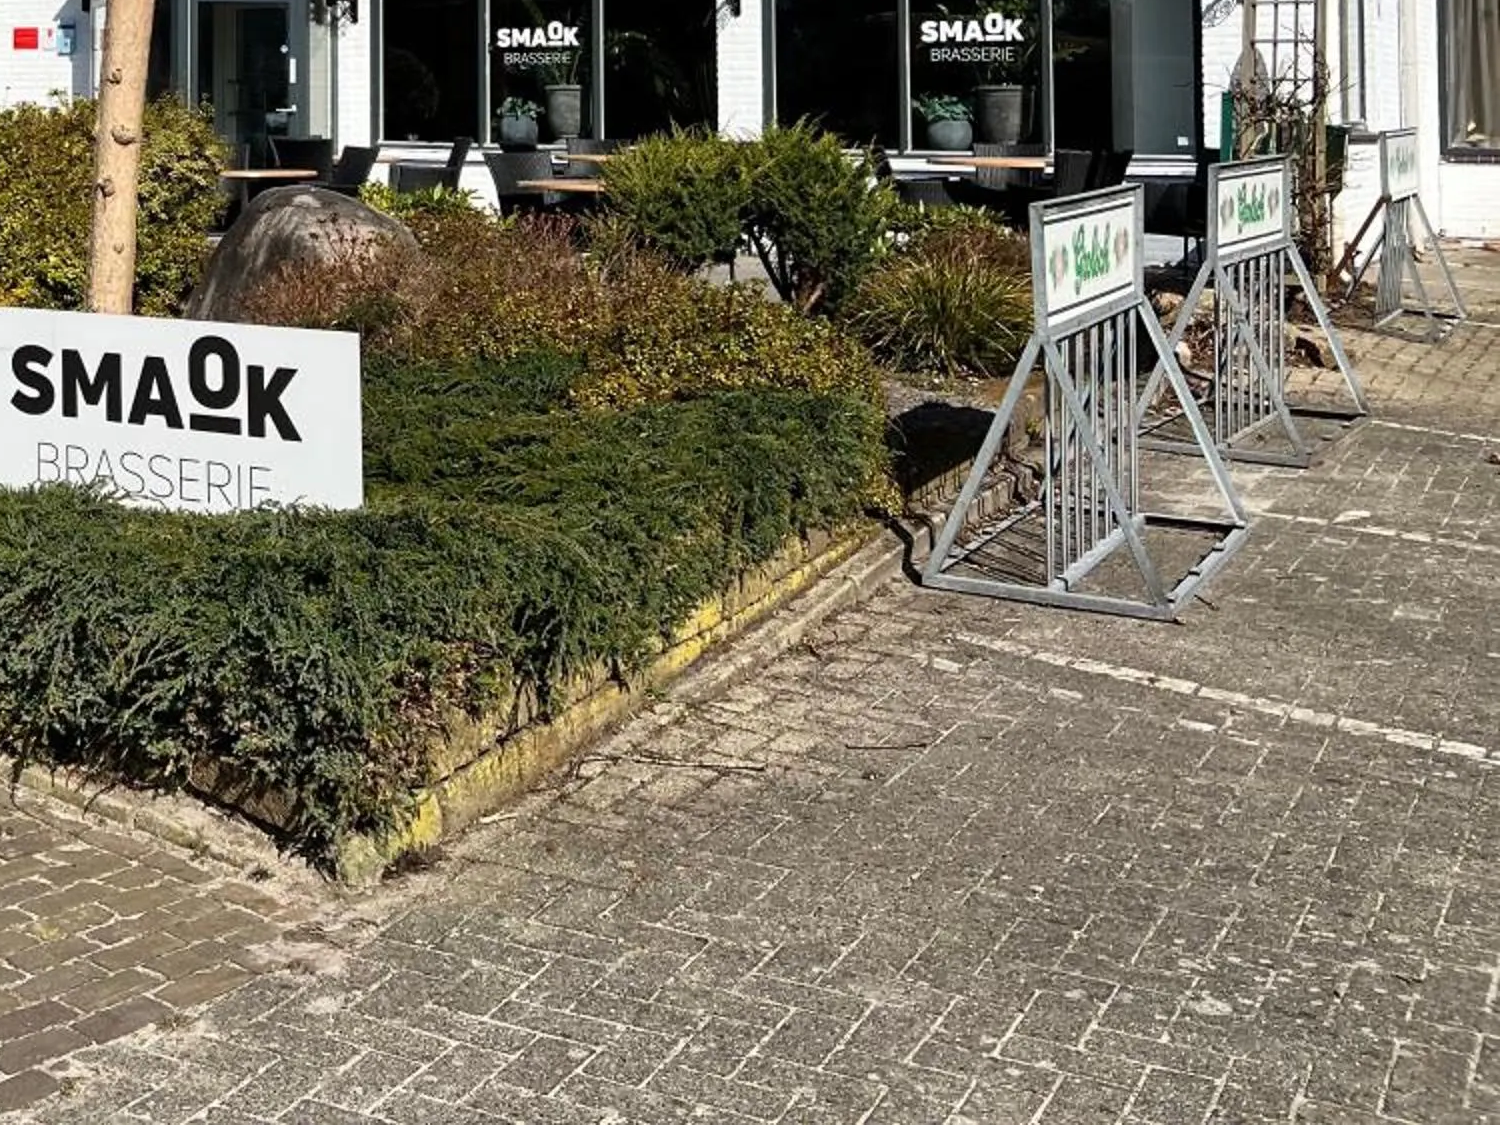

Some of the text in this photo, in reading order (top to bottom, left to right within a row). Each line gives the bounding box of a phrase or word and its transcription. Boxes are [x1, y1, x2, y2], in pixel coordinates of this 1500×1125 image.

[497, 20, 580, 48] SMAOK
[920, 12, 1025, 43] SMAOK
[503, 51, 572, 66] BRASSERIE
[930, 46, 1016, 63] BRASSERIE
[10, 335, 303, 443] SMAOK
